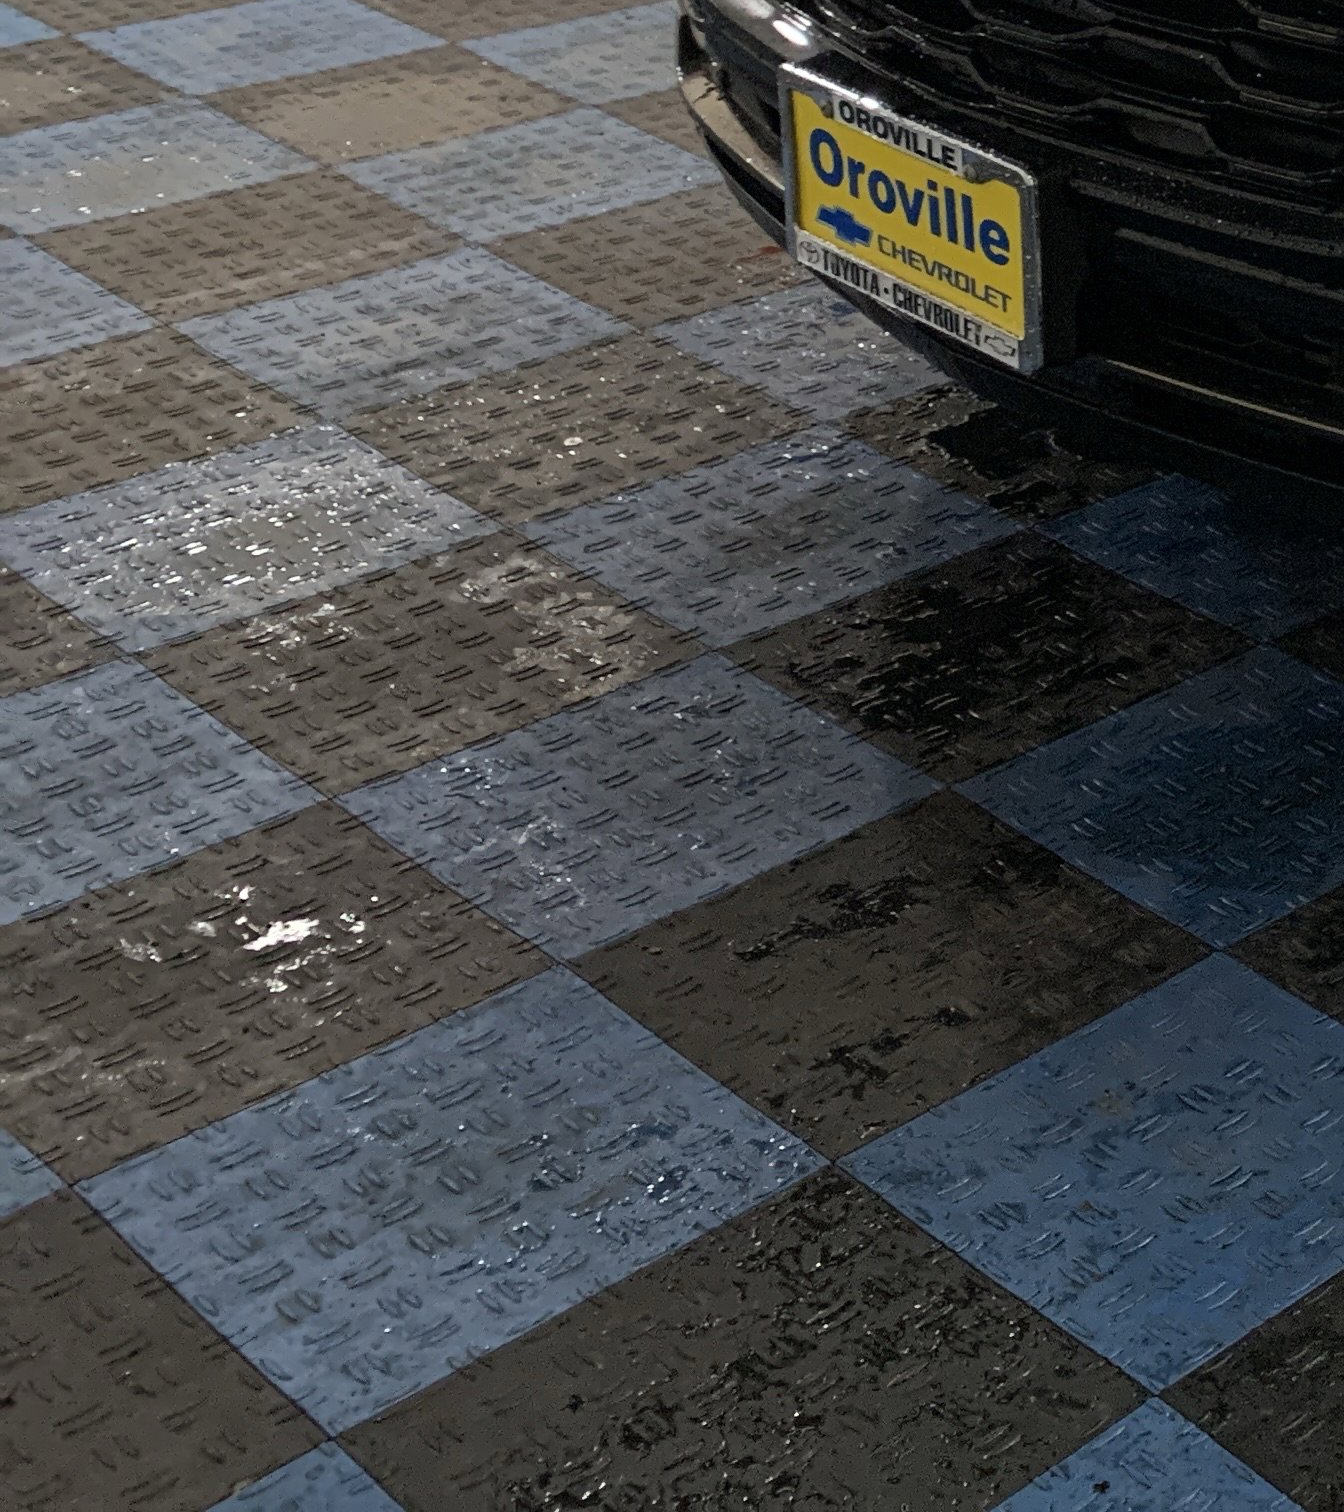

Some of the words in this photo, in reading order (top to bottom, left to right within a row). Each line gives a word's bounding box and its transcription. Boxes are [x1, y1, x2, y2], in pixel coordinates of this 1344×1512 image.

[838, 99, 957, 172] OROVILLE
[809, 127, 1011, 267] Oroville
[820, 248, 881, 298] TOYOTA
[876, 233, 1012, 313] CHEVROLET
